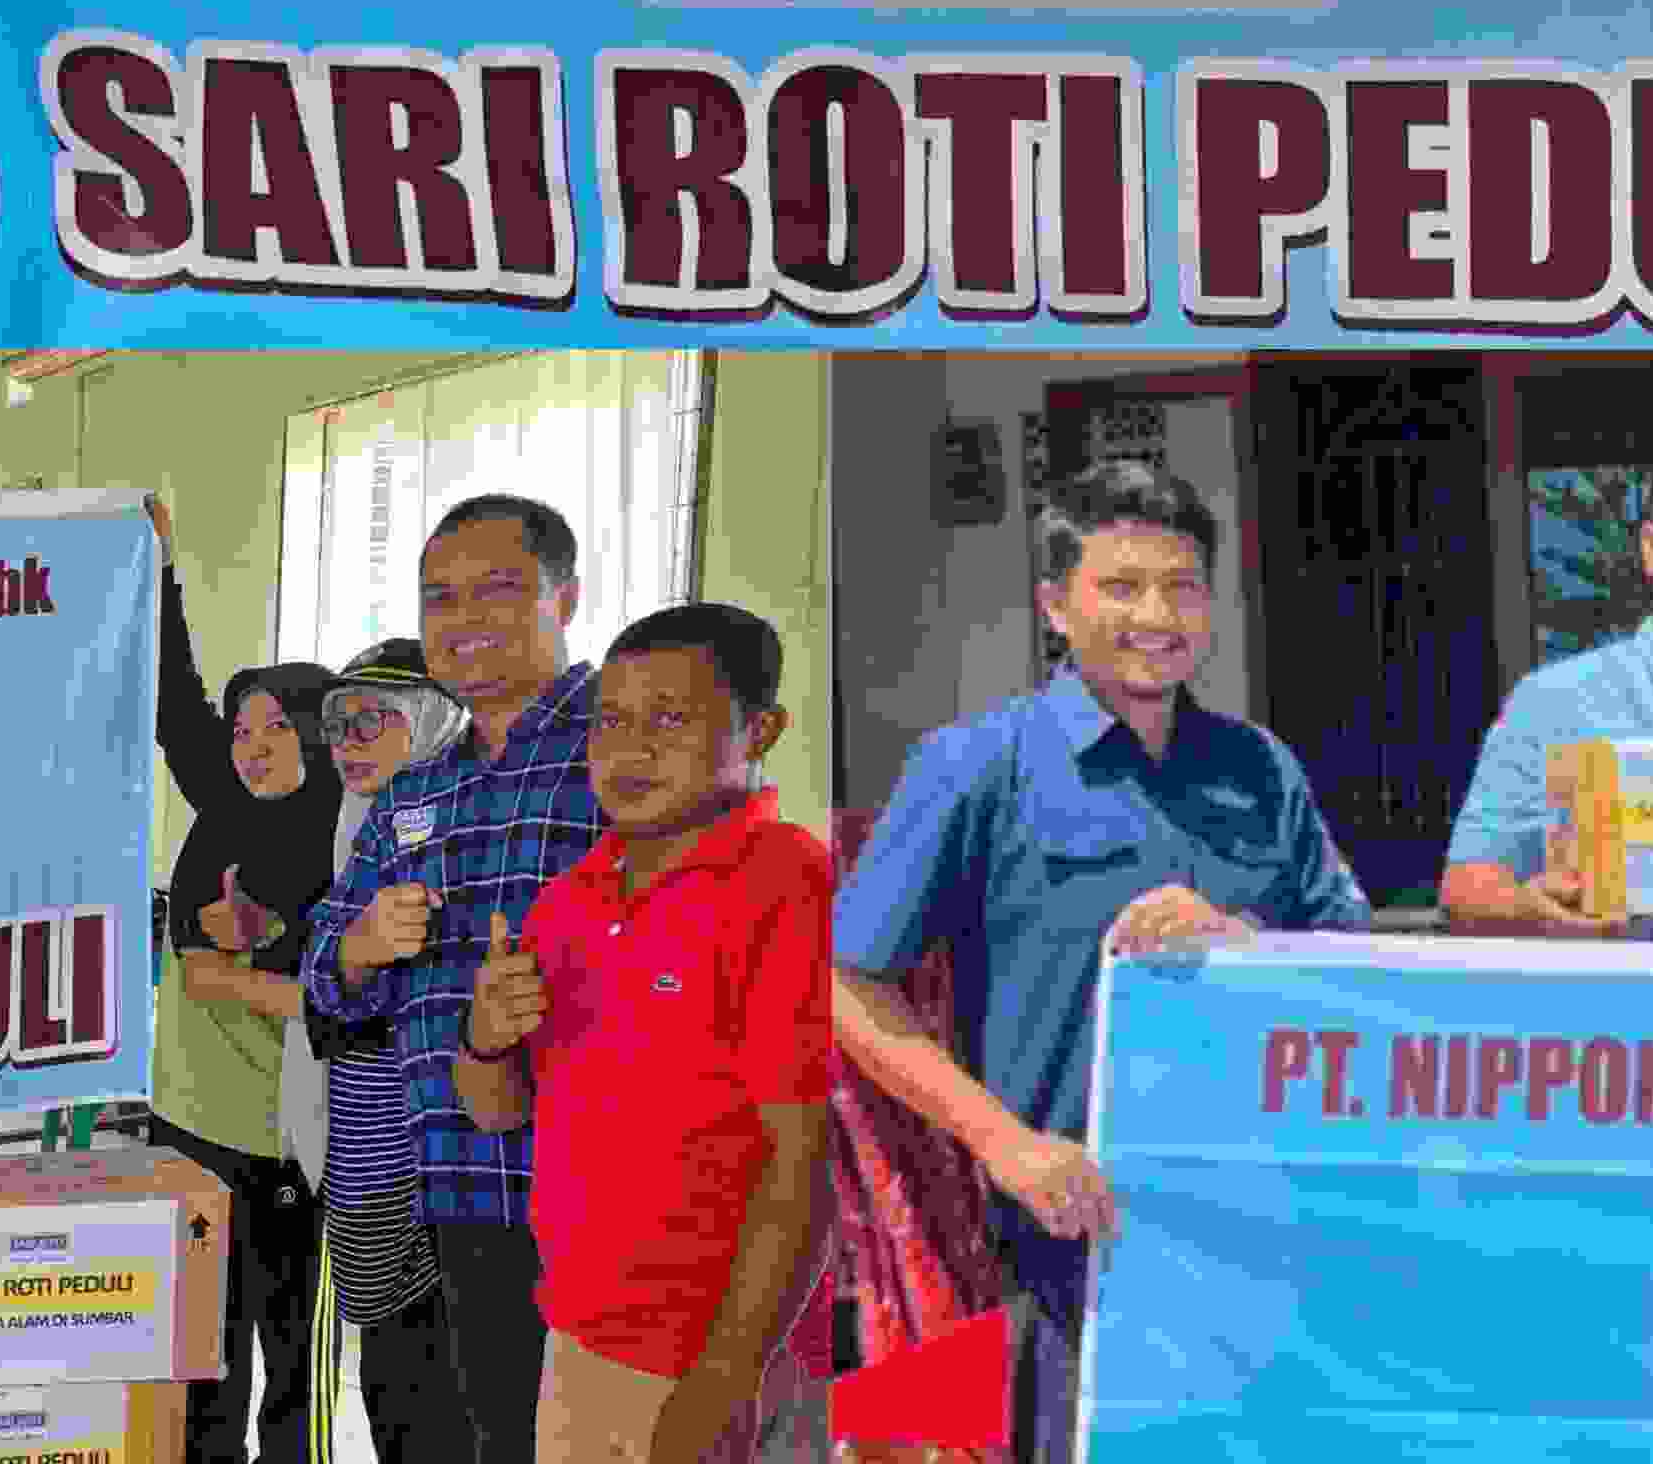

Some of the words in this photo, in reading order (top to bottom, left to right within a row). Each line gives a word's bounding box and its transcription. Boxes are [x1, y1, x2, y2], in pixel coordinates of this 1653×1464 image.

[51, 34, 568, 286] SARI
[606, 58, 1136, 311] ROTI
[1262, 1027, 1365, 1119] PT.
[4, 1276, 52, 1296] ROTI
[58, 1272, 134, 1294] PEDULI
